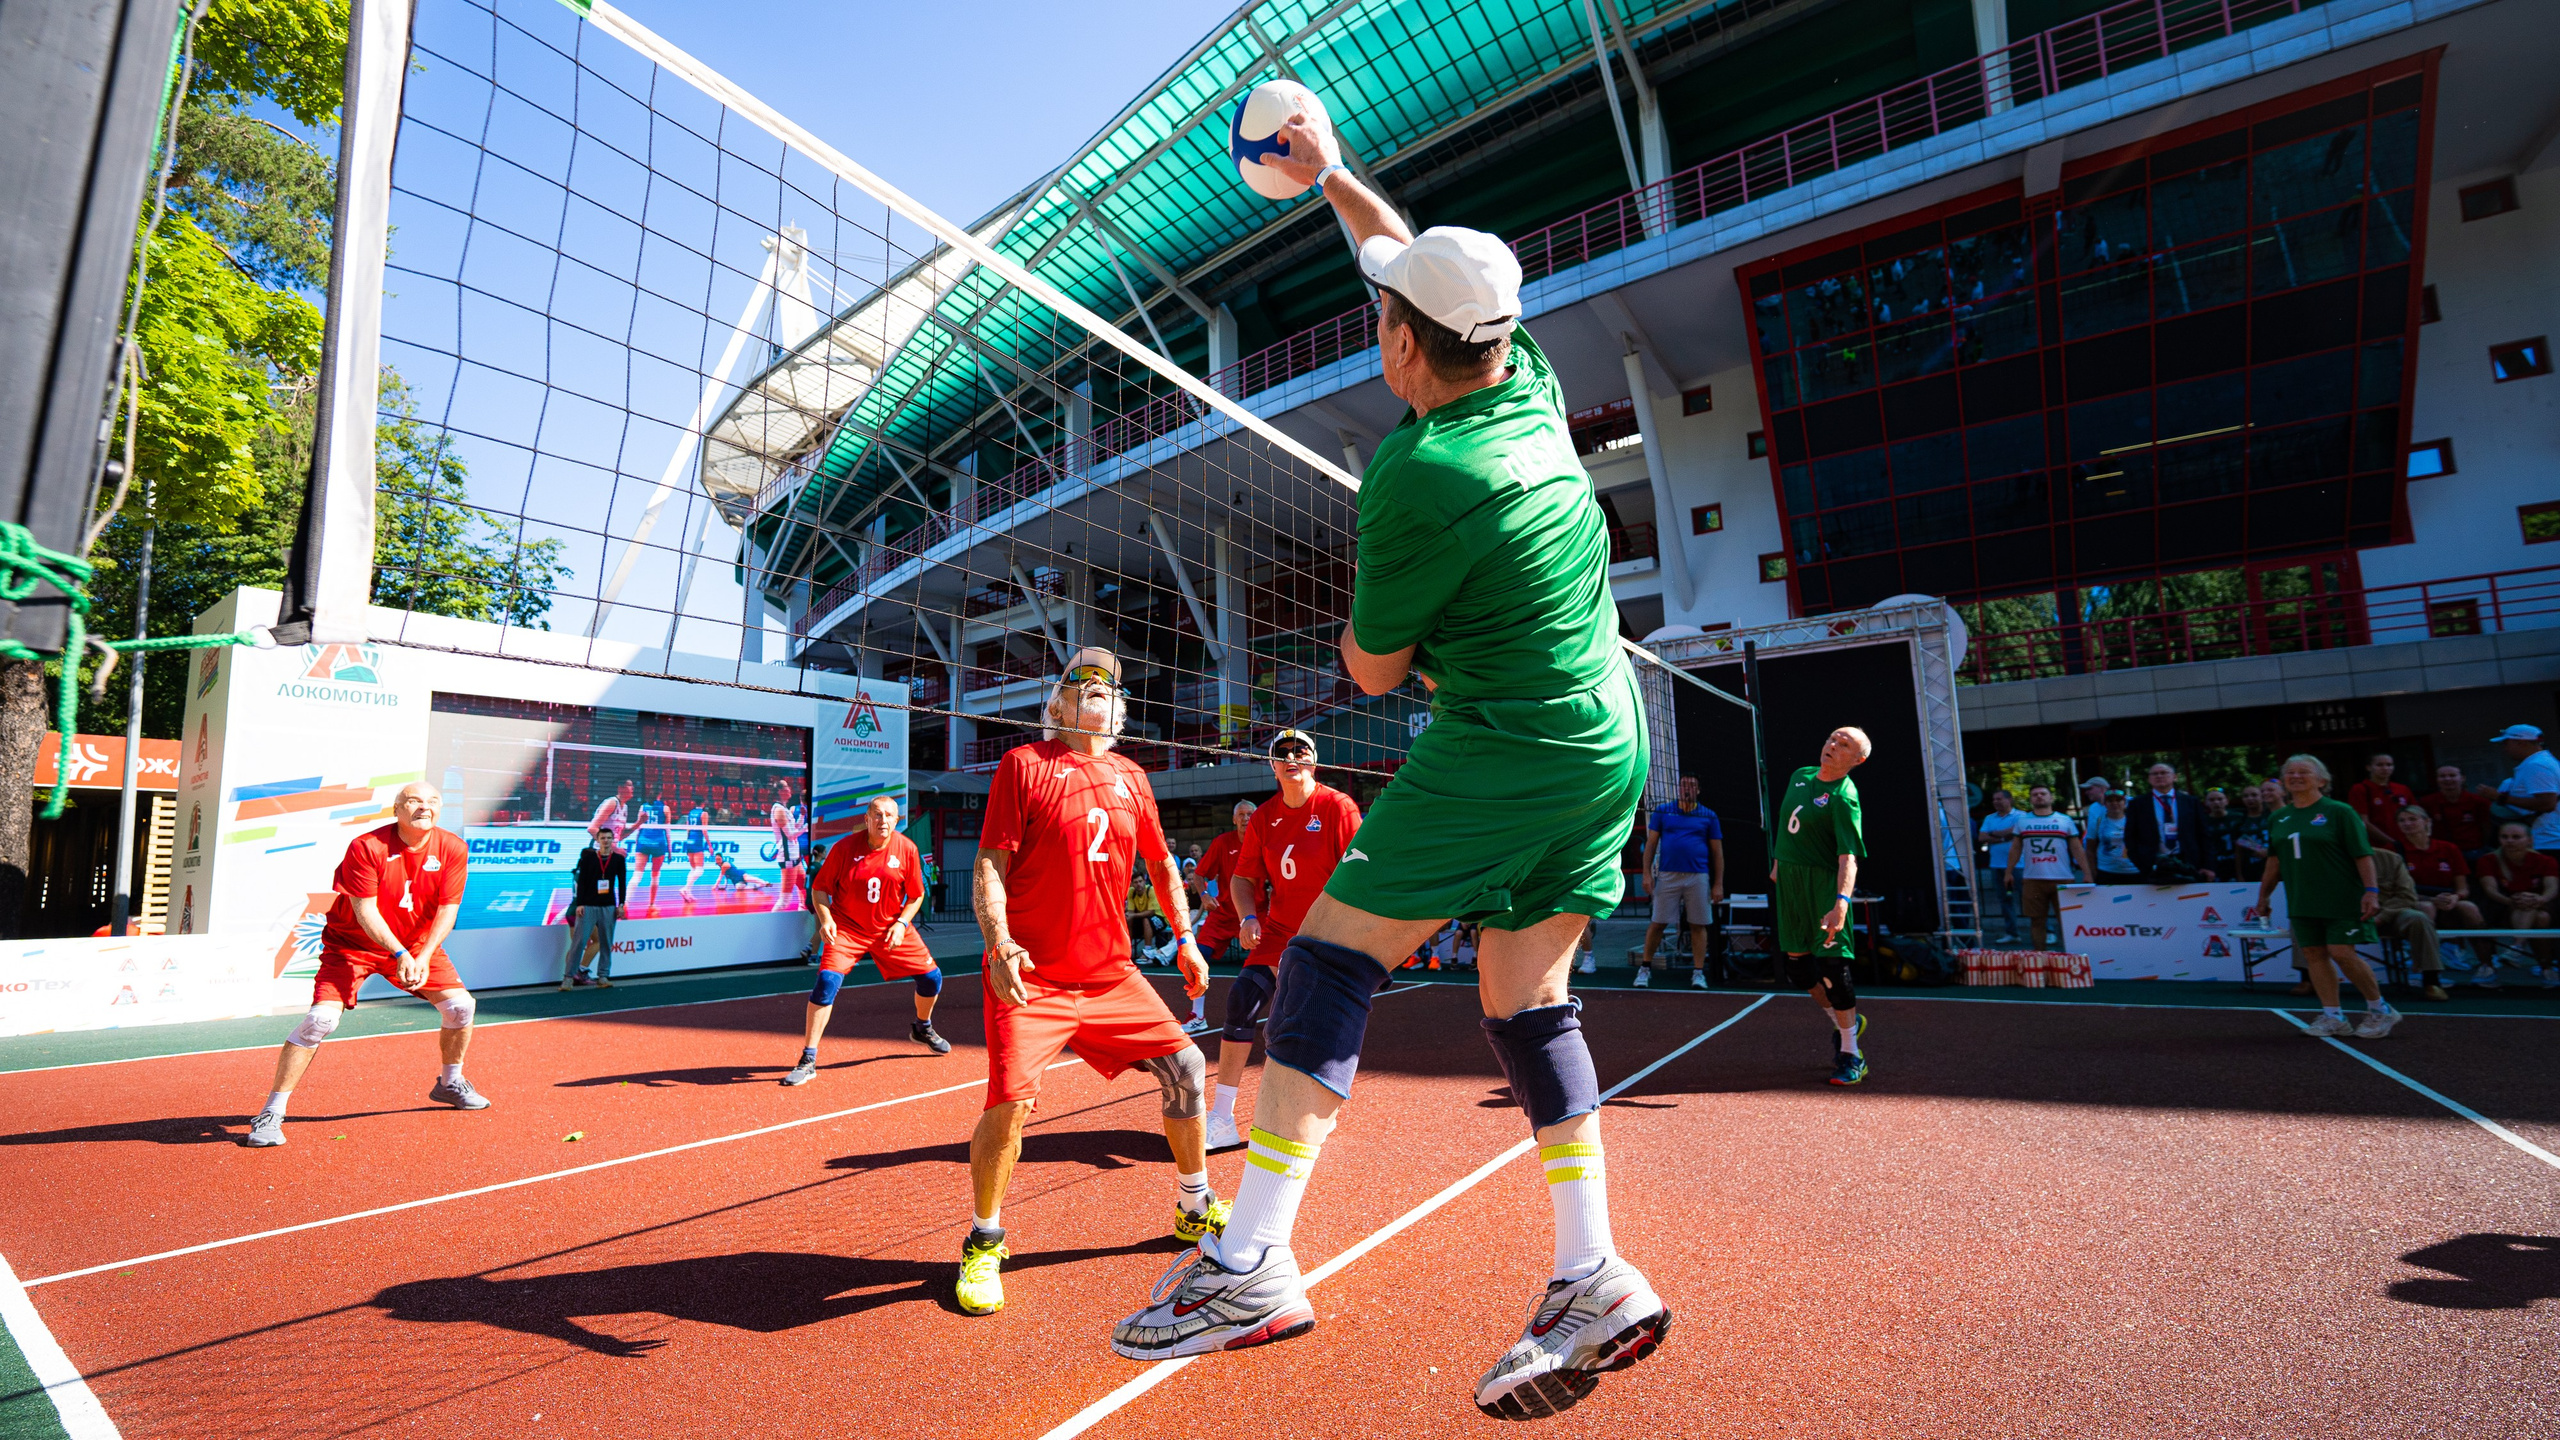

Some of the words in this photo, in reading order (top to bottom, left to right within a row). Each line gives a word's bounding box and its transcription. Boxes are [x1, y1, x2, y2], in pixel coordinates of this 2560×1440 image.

[277, 683, 399, 707] ЛОКОМОТИВ
[834, 738, 890, 749] ЛОКОМОТИВ
[962, 794, 979, 810] 18
[1788, 805, 1804, 834] 6
[1087, 807, 1110, 862] 2
[2029, 838, 2056, 855] 54
[2287, 832, 2302, 859] 1
[1280, 844, 1297, 880] 6
[398, 880, 414, 912] 4
[867, 876, 881, 904] 8
[2074, 923, 2163, 938] ЛокоТех
